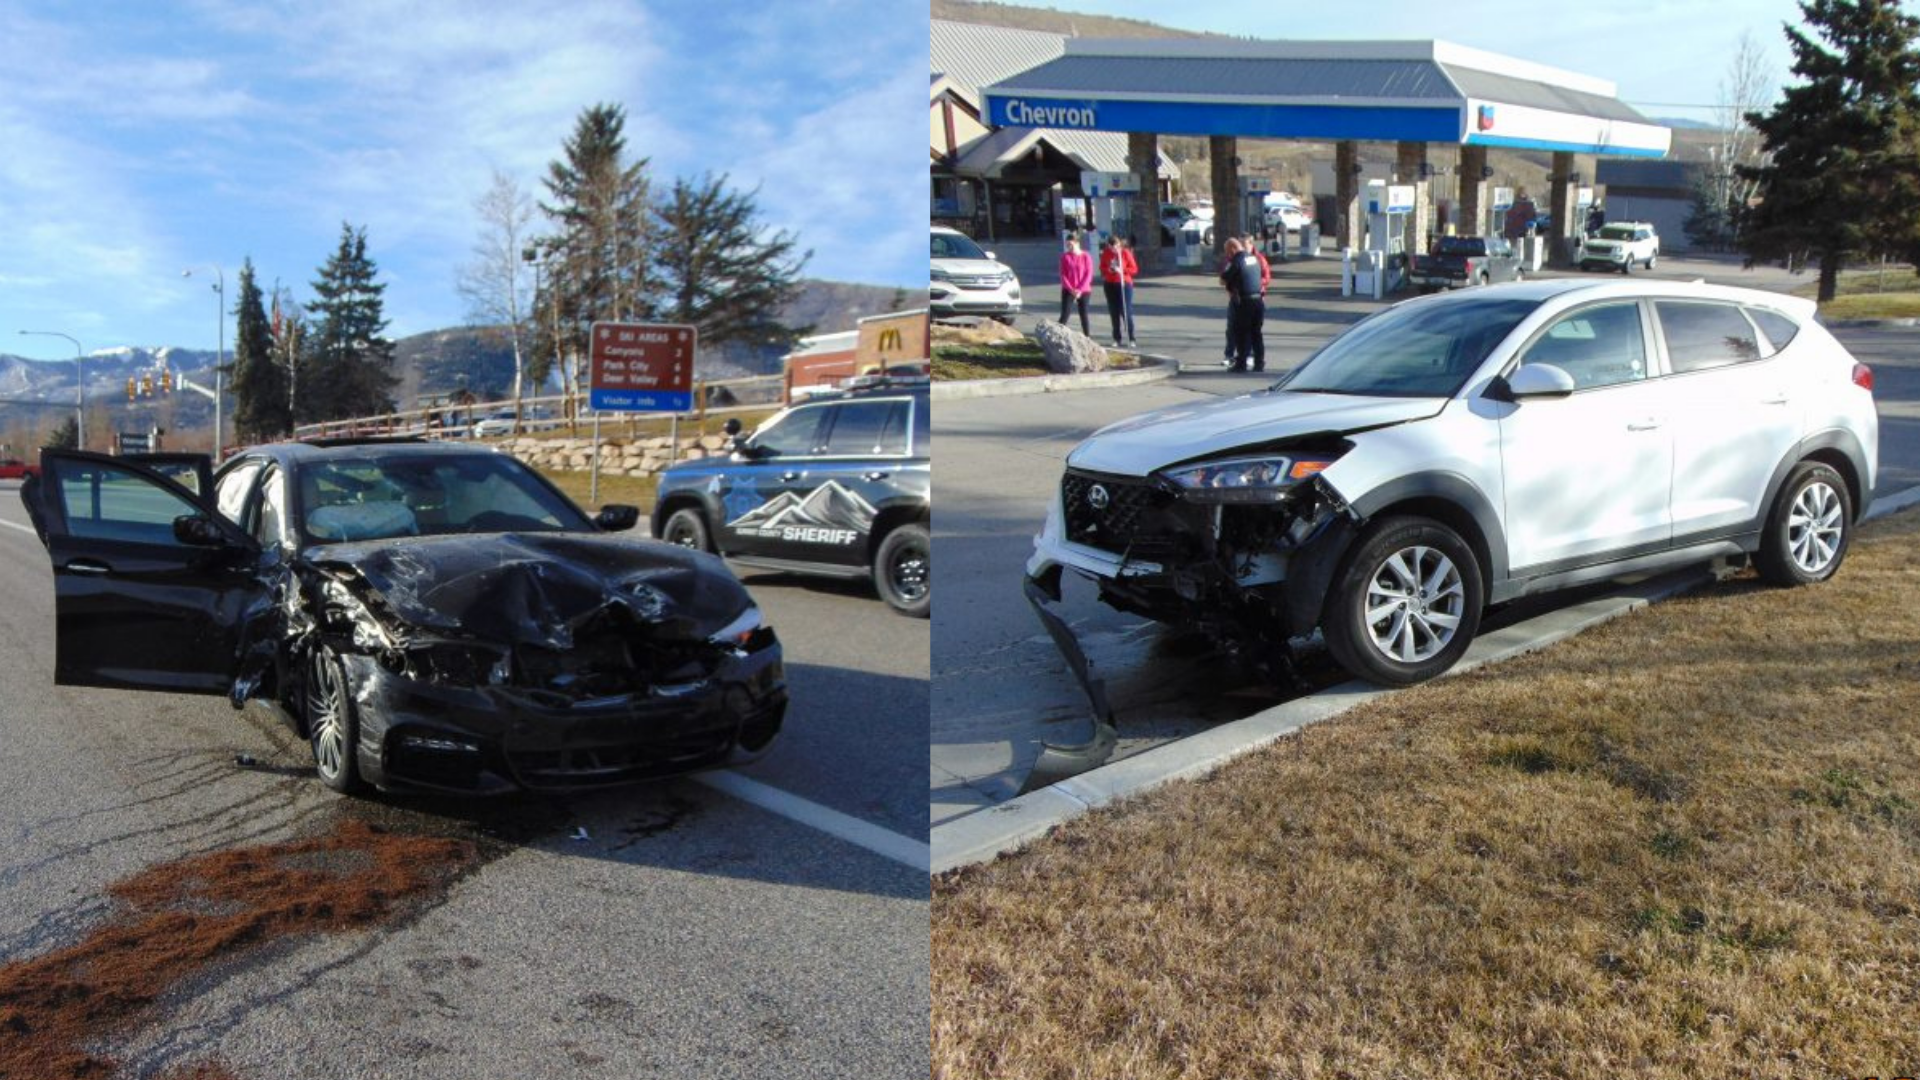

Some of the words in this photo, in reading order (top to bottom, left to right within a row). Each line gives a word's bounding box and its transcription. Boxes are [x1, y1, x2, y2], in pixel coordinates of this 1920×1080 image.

[1006, 100, 1095, 127] Chevron
[619, 331, 635, 341] SKI
[638, 333, 669, 343] AREAS
[604, 345, 645, 357] Canyons
[603, 360, 626, 370] Park
[629, 361, 650, 373] City
[602, 374, 625, 383] Deer
[629, 374, 659, 386] Valley
[602, 396, 633, 405] Visitor
[783, 526, 857, 545] SHERIFF
